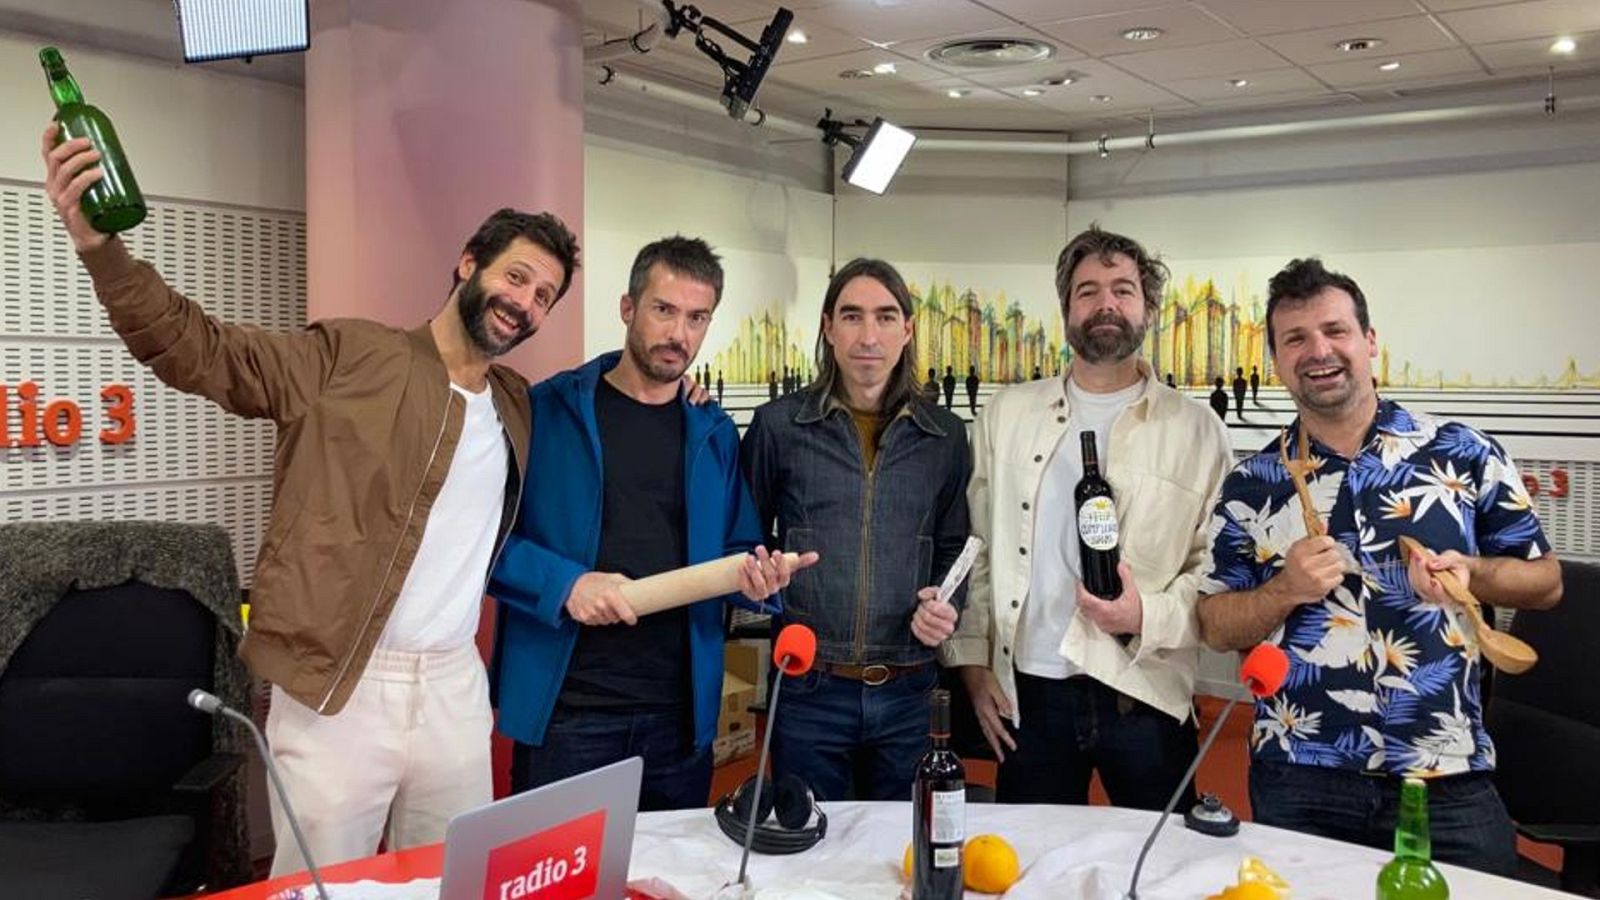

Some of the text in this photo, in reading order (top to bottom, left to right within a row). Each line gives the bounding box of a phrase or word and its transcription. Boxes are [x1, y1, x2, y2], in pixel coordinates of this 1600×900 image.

[99, 385, 136, 445] 3
[1550, 469, 1569, 498] 3
[500, 845, 588, 900] radio 3
